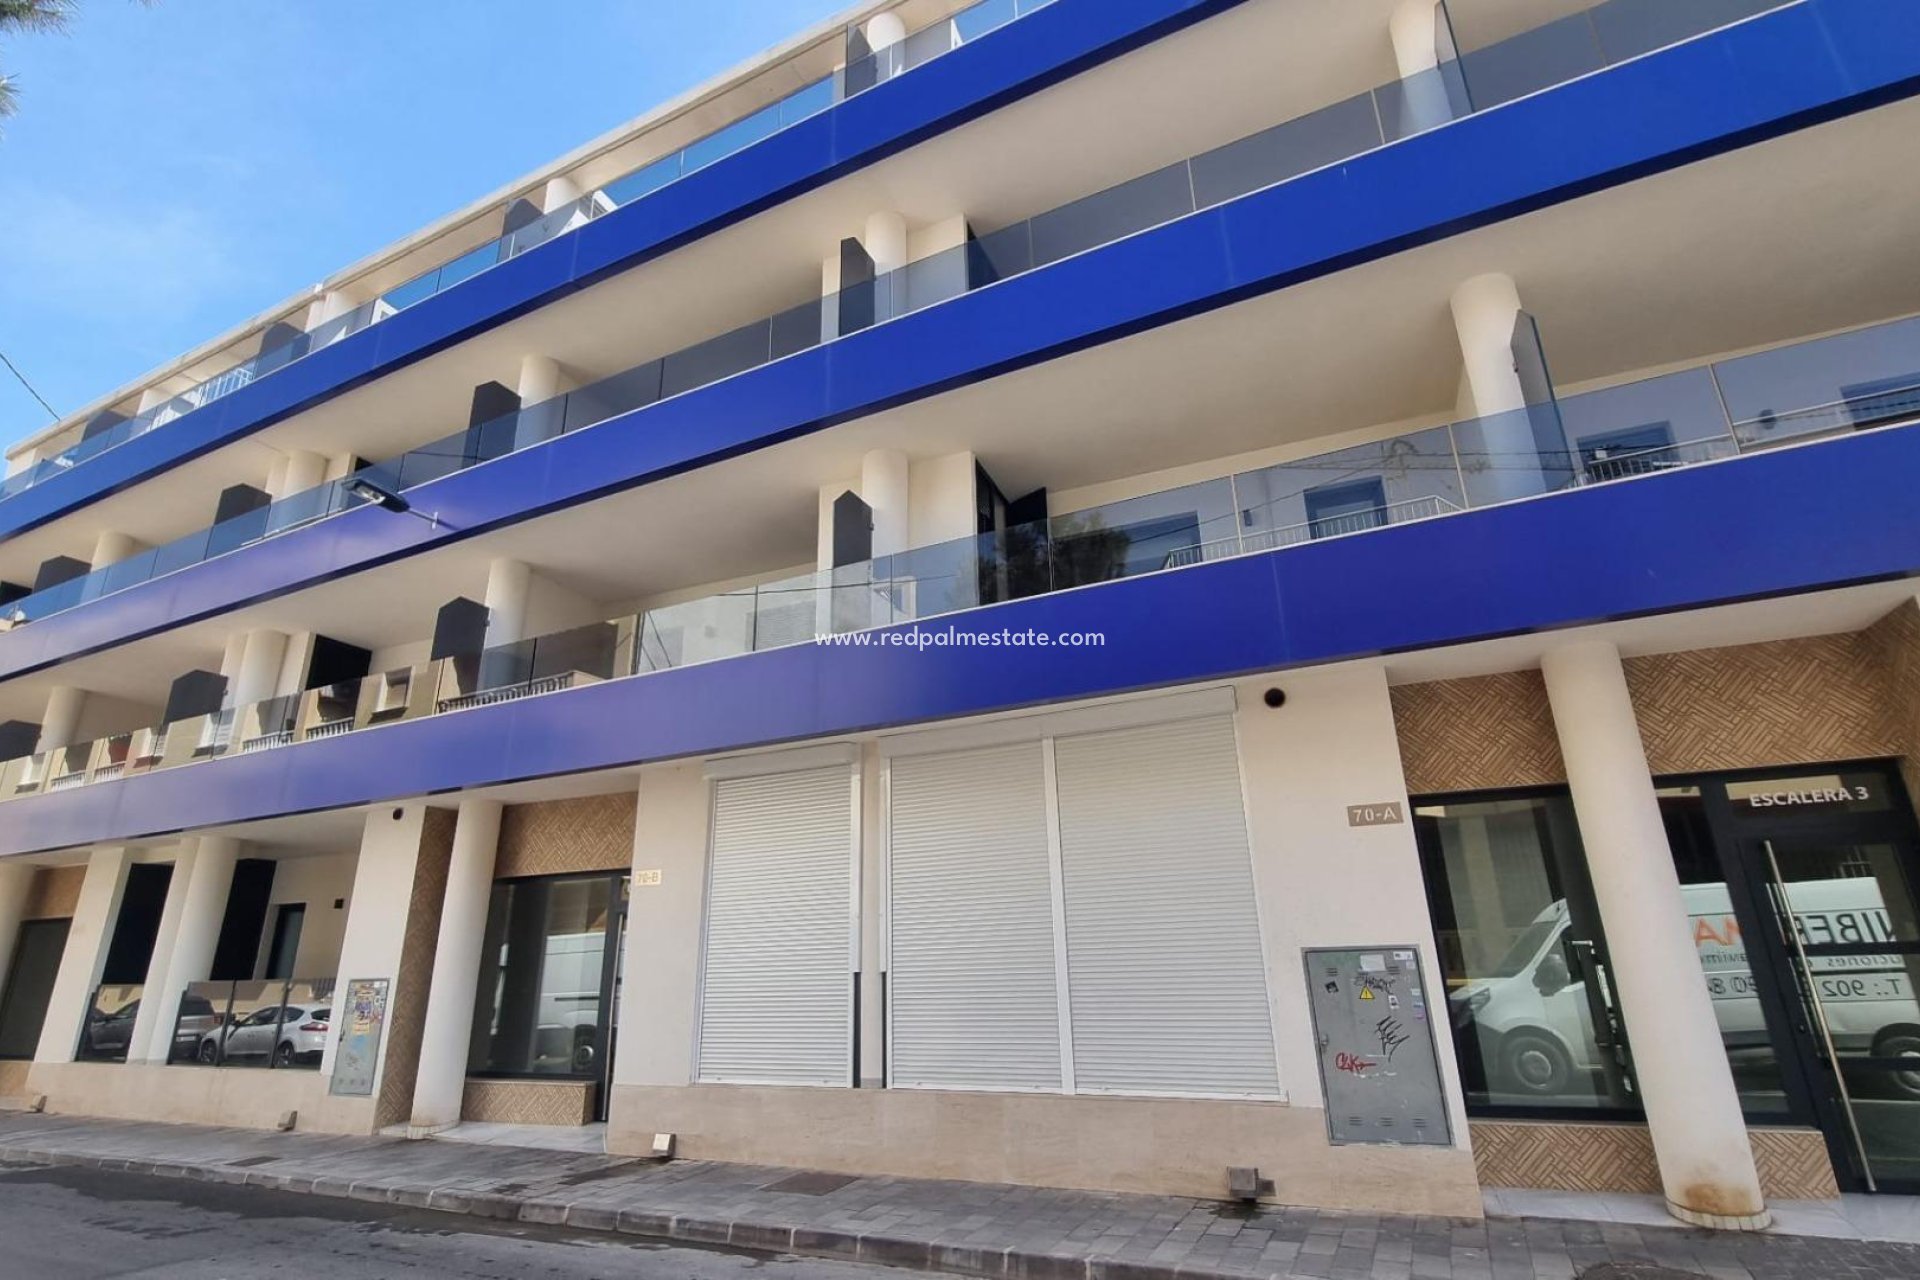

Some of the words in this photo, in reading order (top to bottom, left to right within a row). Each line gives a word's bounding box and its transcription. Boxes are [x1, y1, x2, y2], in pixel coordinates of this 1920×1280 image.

[1749, 787, 1853, 807] ESCALERA
[1855, 786, 1869, 800] 3
[1352, 806, 1398, 822] 70-A
